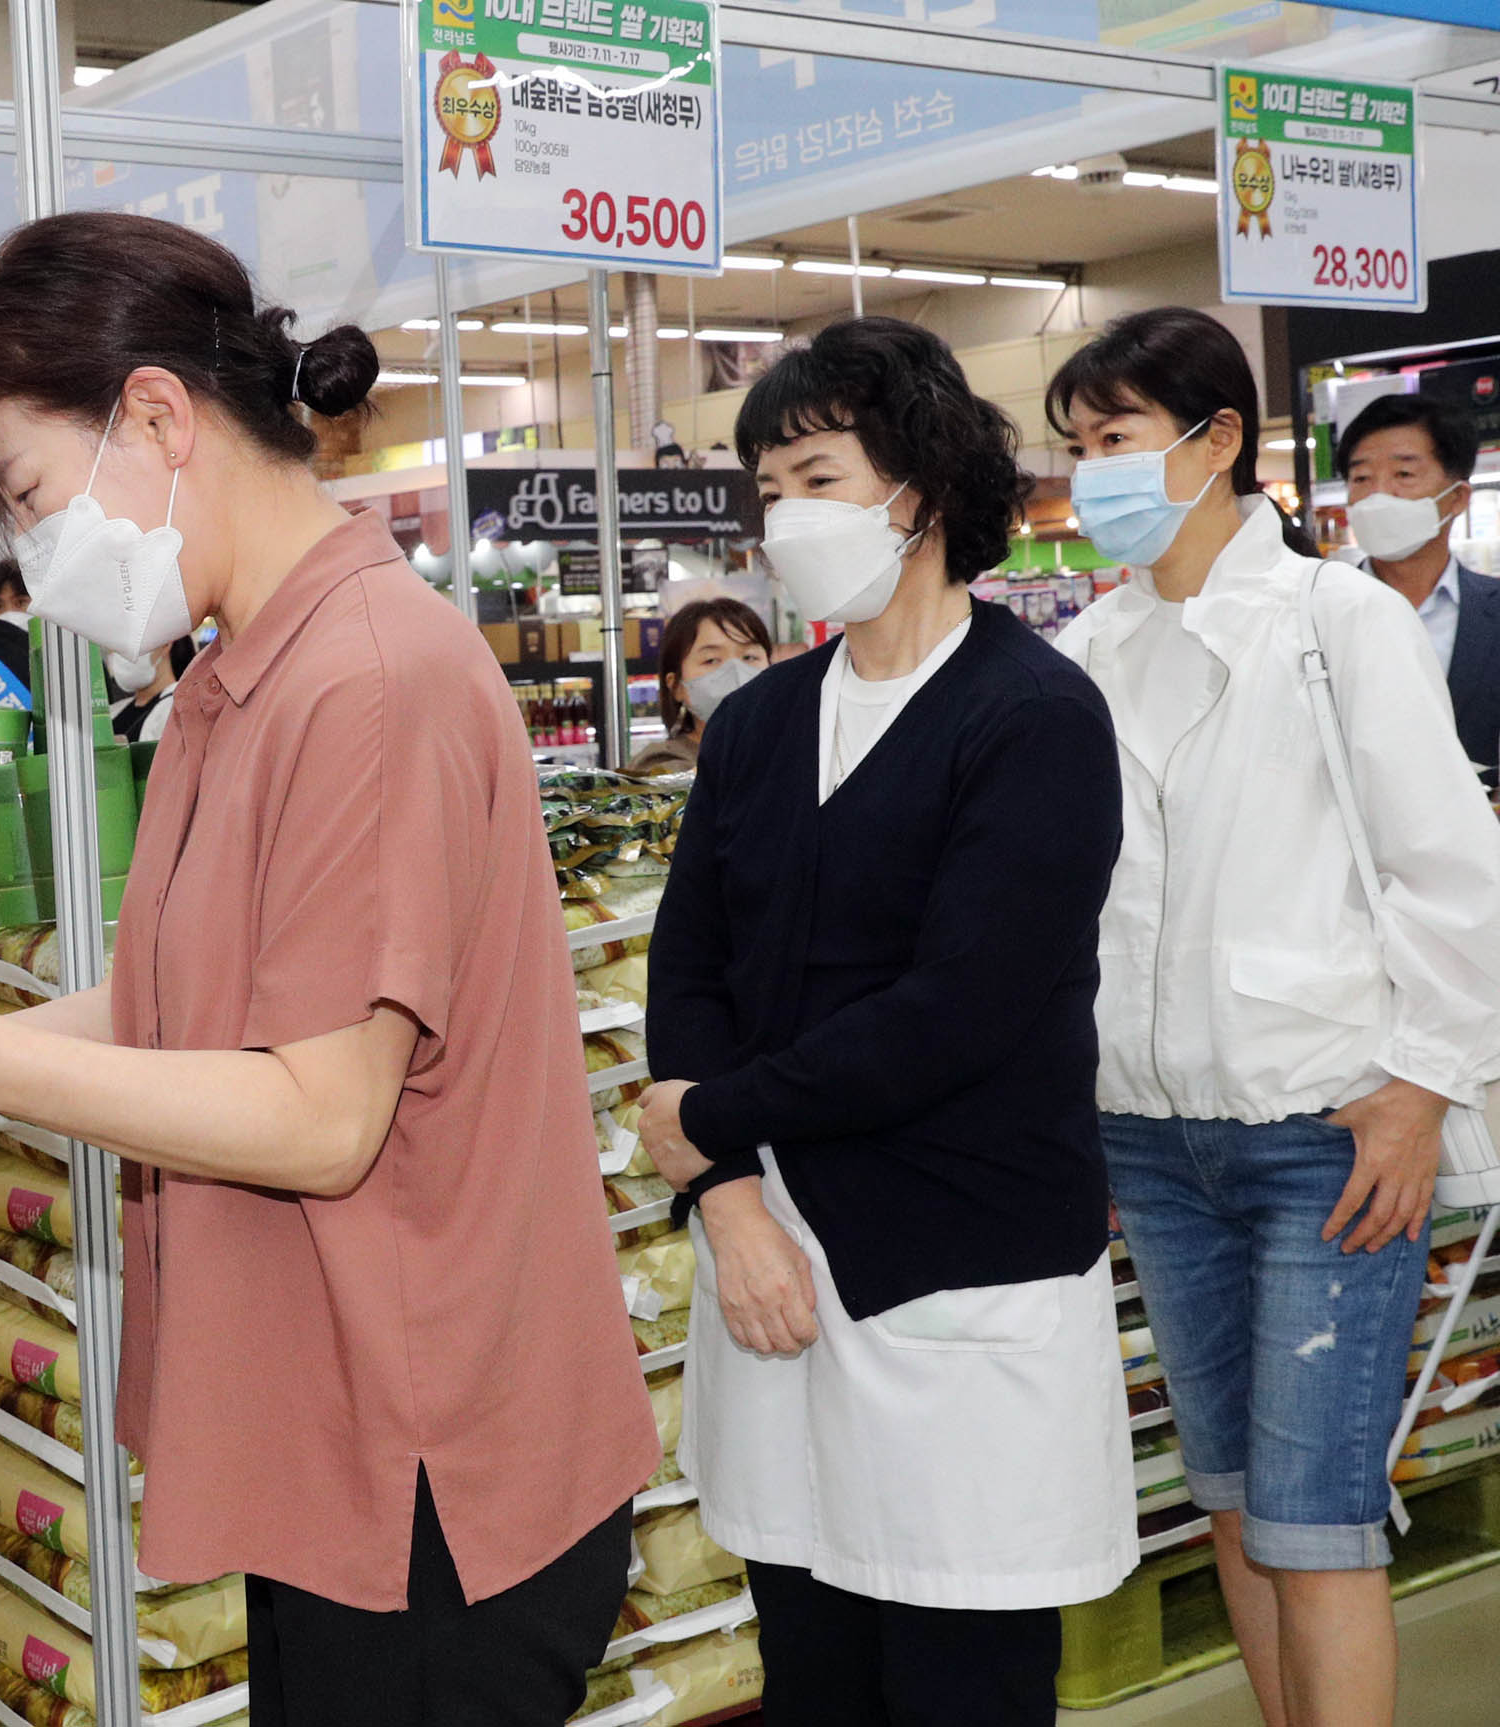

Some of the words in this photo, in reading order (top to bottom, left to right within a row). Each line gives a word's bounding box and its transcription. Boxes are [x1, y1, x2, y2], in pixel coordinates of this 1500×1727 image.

[432, 28, 477, 46] 전라남도
[485, 0, 535, 26] 10대
[540, 0, 613, 36] 브랜드
[620, 4, 647, 40] 쌀
[650, 15, 704, 49] 기획전
[443, 96, 496, 119] 최우수상
[1262, 83, 1298, 114] 10대
[1298, 87, 1347, 119] 브랜드
[1350, 92, 1368, 122] 쌀
[514, 119, 536, 137] 10kg
[514, 138, 570, 158] 100g/305원
[1238, 173, 1270, 193] 우수상
[1281, 154, 1335, 185] 나누우리
[1338, 160, 1403, 192] 쌀(새청무)
[561, 188, 707, 251] 30,500
[1312, 244, 1408, 290] 28,300
[568, 484, 668, 514] famers
[673, 486, 702, 514] to
[706, 486, 727, 514] U
